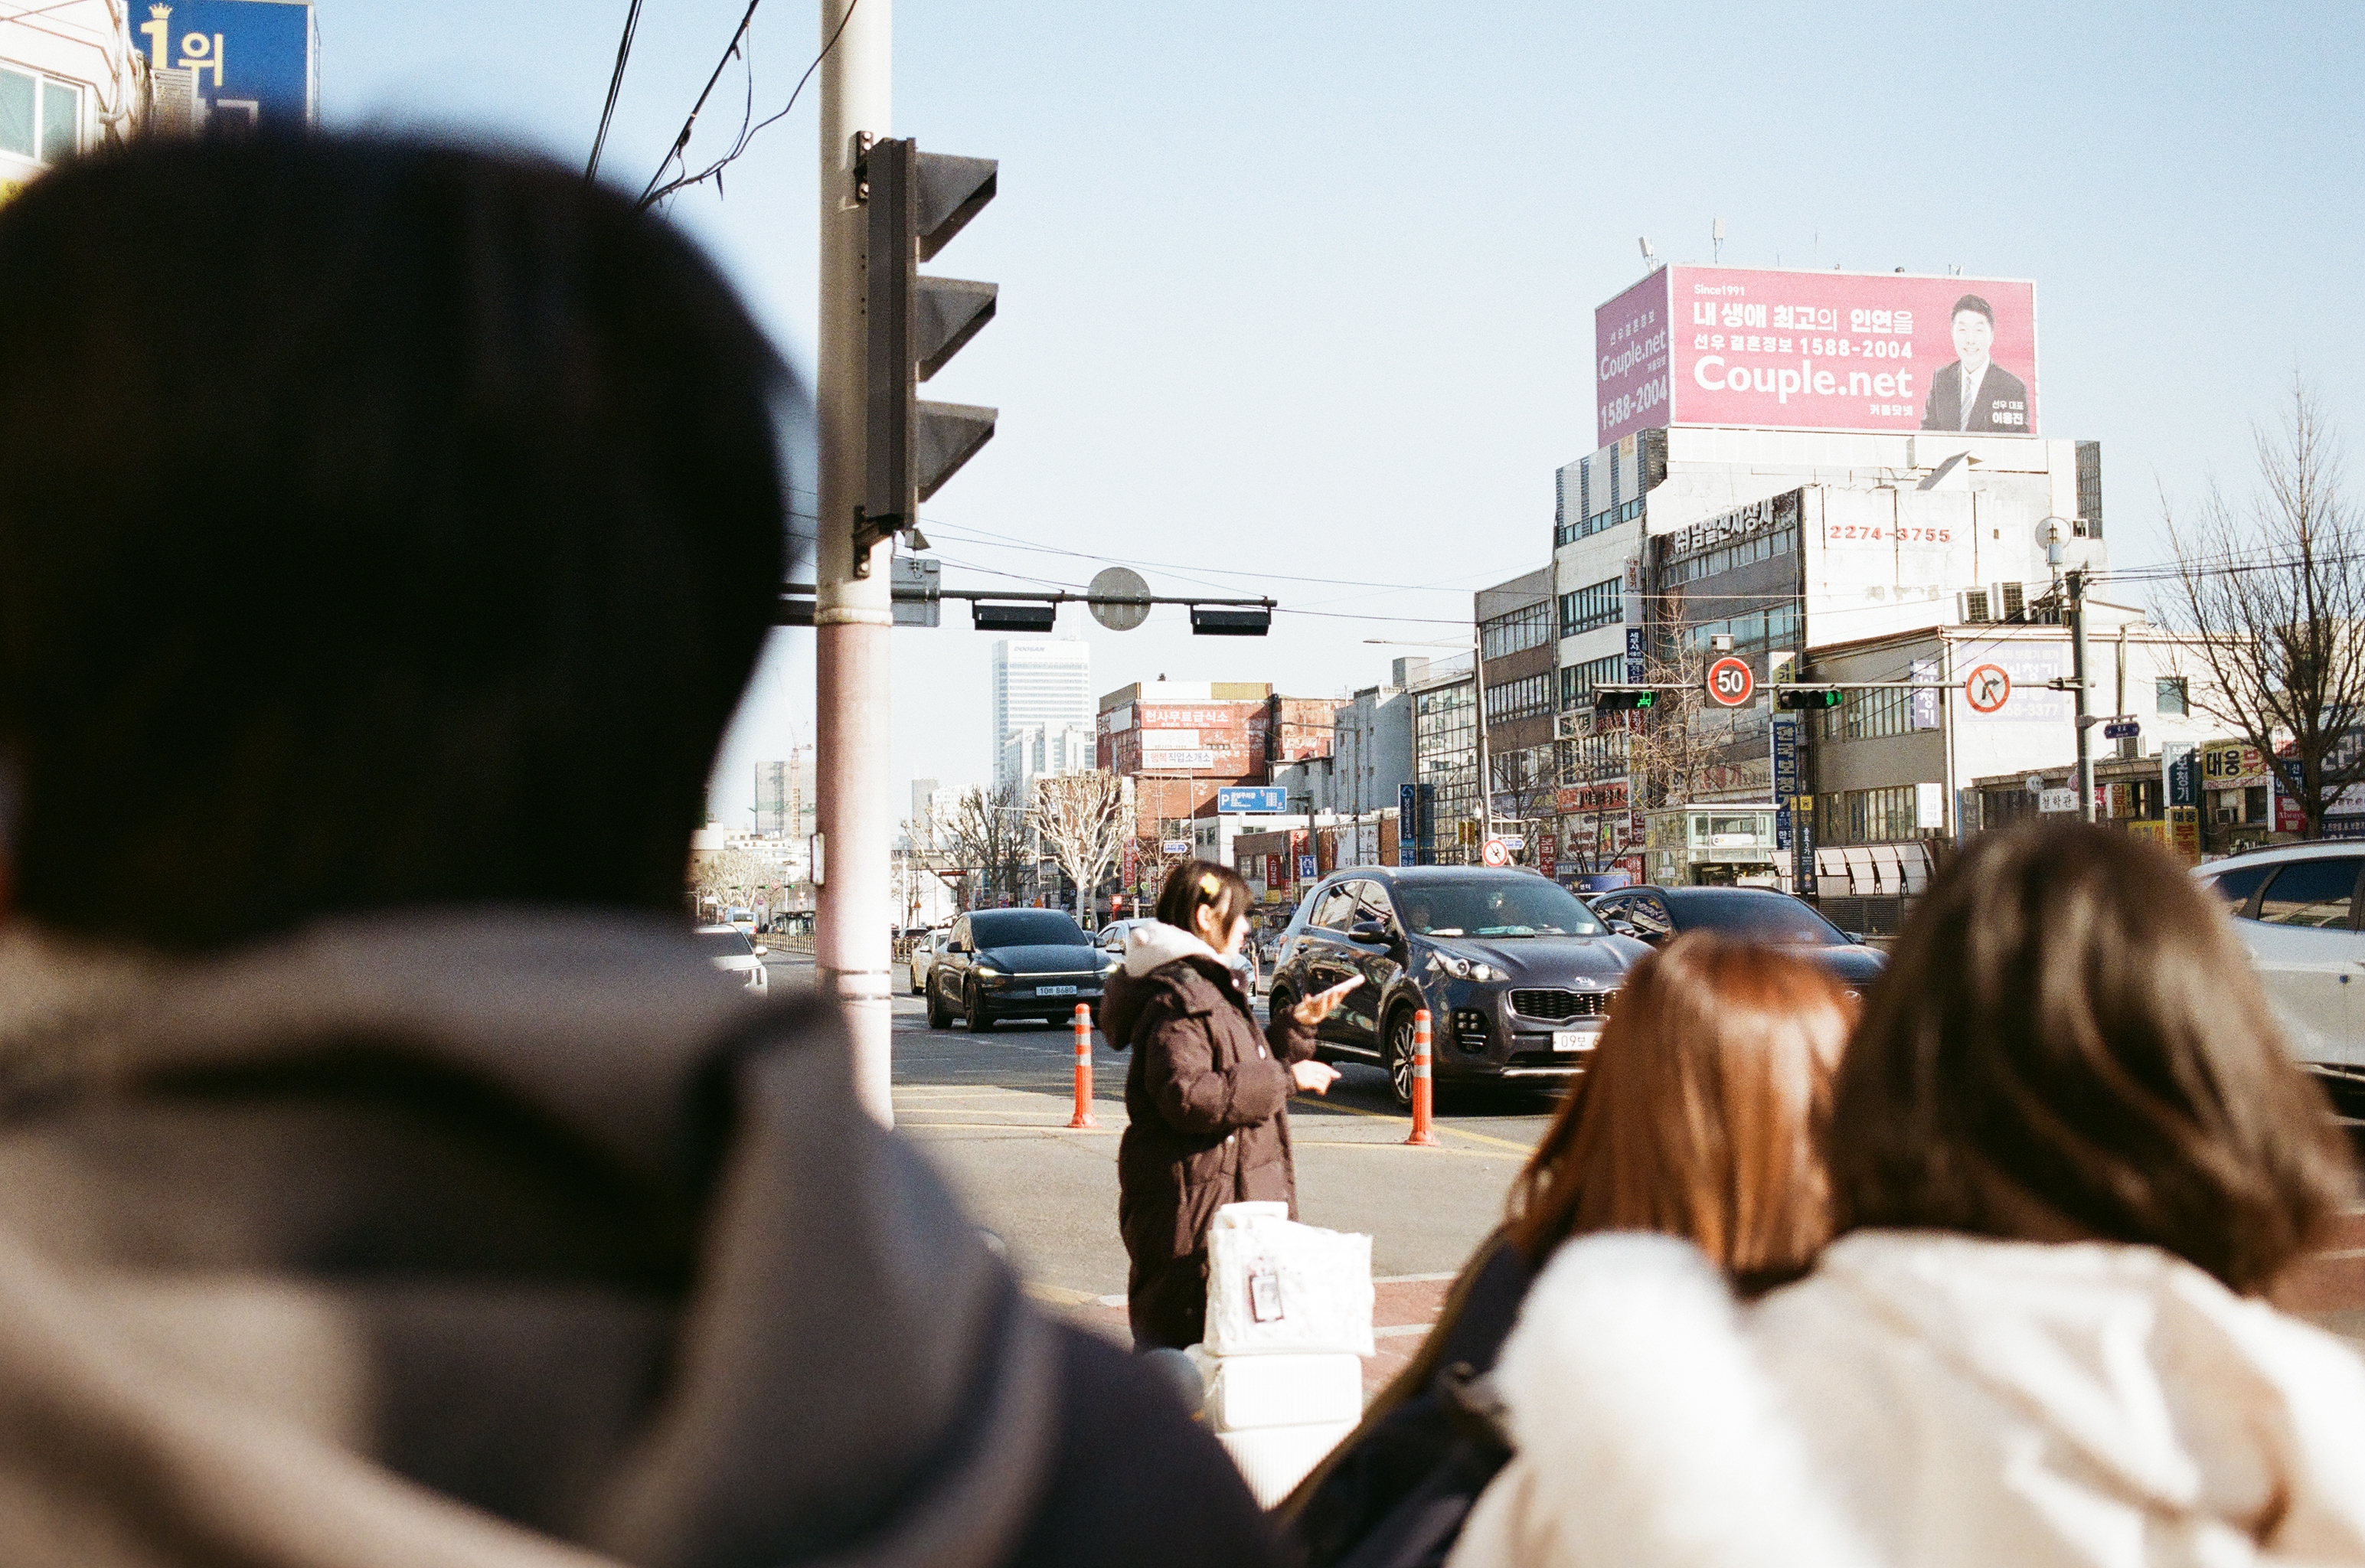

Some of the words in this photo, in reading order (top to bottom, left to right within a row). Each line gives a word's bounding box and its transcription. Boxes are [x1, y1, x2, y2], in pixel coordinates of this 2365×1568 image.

[1694, 284, 1745, 296] Since1991
[1694, 302, 1716, 326] 내
[1720, 303, 1766, 328] 생애
[1773, 305, 1837, 332] 최고의
[1850, 308, 1913, 334] 인연을
[1600, 328, 1666, 381] Couple.net
[1694, 335, 1726, 351] 선우
[1730, 335, 1793, 353] 결혼정보
[1799, 338, 1913, 358] 1588-2004
[1694, 355, 1913, 403] Couple.net
[1601, 374, 1667, 430] 1588-2004
[1870, 404, 1913, 416] 커플닷넷
[1992, 400, 2007, 410] 선우
[2009, 401, 2024, 410] 대표
[1830, 525, 1950, 543] 2274-3755
[1717, 670, 1743, 693] 50
[1145, 710, 1229, 723] 천사무료급식소
[1150, 752, 1210, 763] 행복직업소개소
[2207, 750, 2240, 777] 대웅
[2177, 755, 2190, 802] 보청기
[2042, 795, 2072, 811] 철학관
[2278, 812, 2307, 820] Always
[1803, 827, 1811, 856] 종로3가
[1561, 1035, 1586, 1047] 09보
